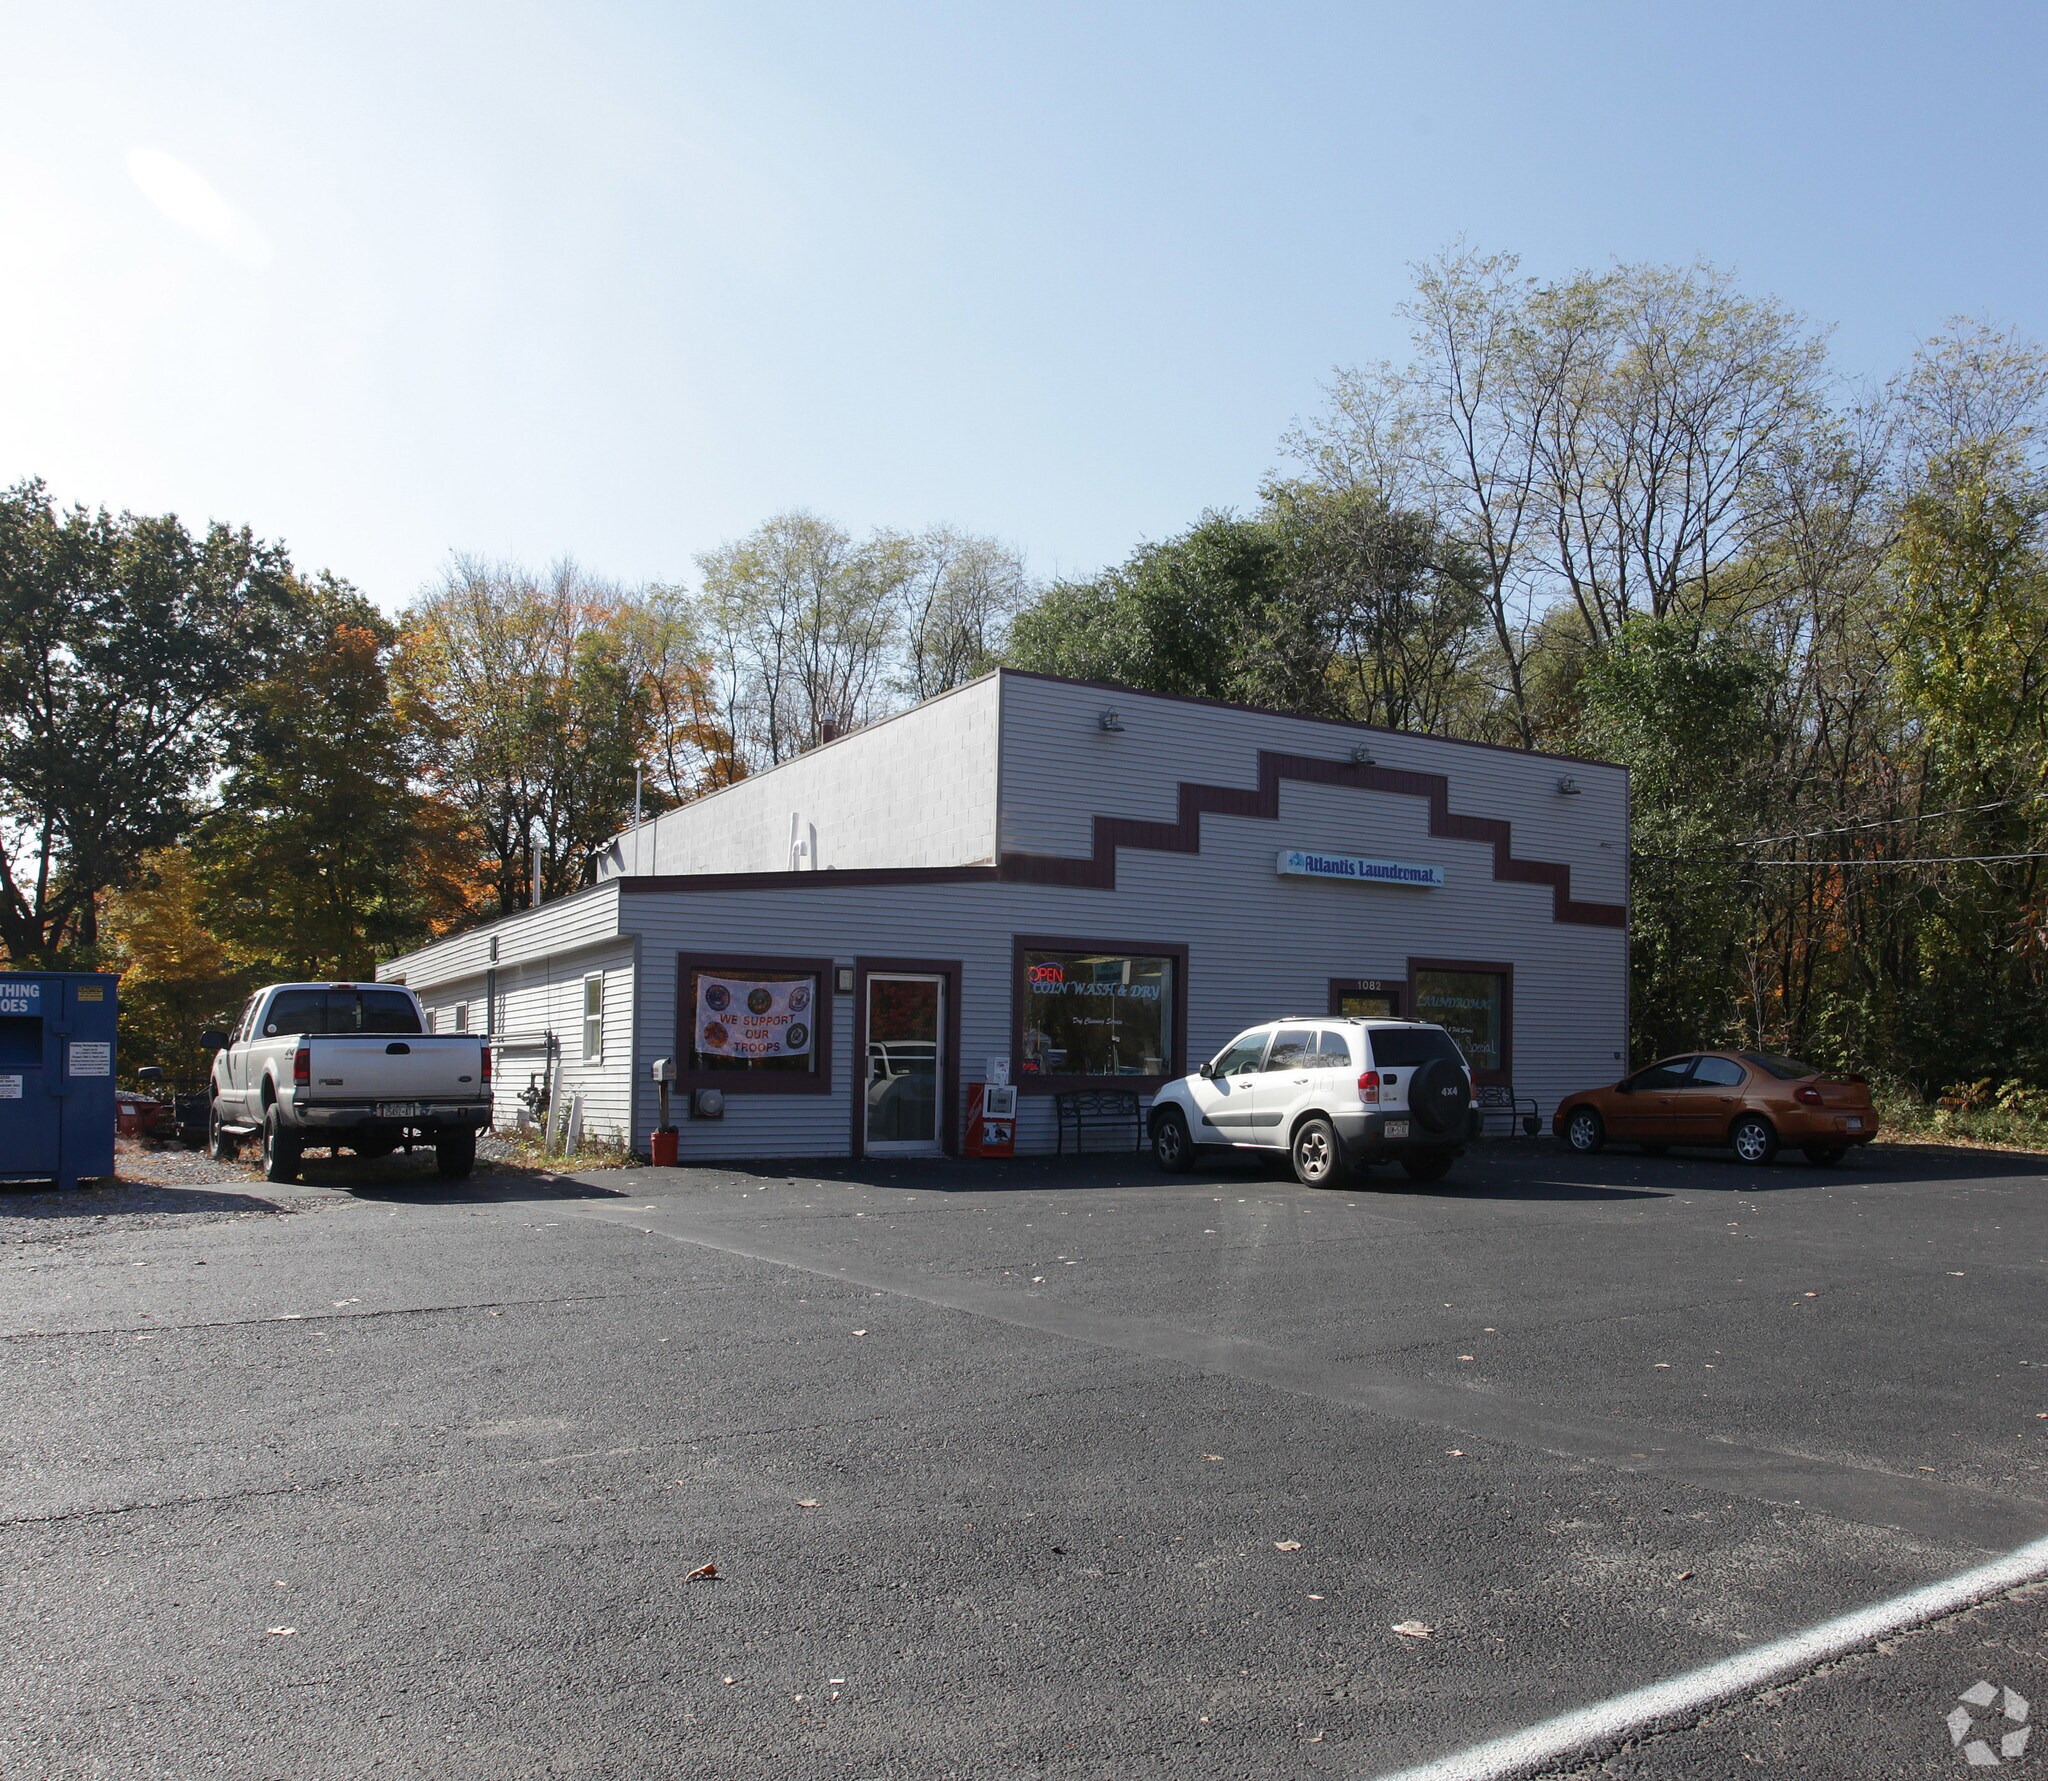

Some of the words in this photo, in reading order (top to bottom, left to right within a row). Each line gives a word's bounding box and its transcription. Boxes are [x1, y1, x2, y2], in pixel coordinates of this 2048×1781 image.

[1305, 855, 1355, 876] Atlantis
[1029, 966, 1063, 982] OPEN
[1033, 981, 1069, 995] COIN
[1071, 981, 1117, 996] WASH
[1118, 984, 1127, 996] &
[1130, 985, 1160, 1000] DRY
[1358, 981, 1381, 991] 1082
[1416, 995, 1495, 1010] LAUNDROMAT
[720, 1014, 738, 1024] WE
[743, 1014, 796, 1026] SUPPORT
[1072, 1017, 1083, 1025] Dry
[745, 1030, 769, 1039] OUR
[734, 1042, 780, 1052] TROOPS
[1464, 1035, 1496, 1057] Special
